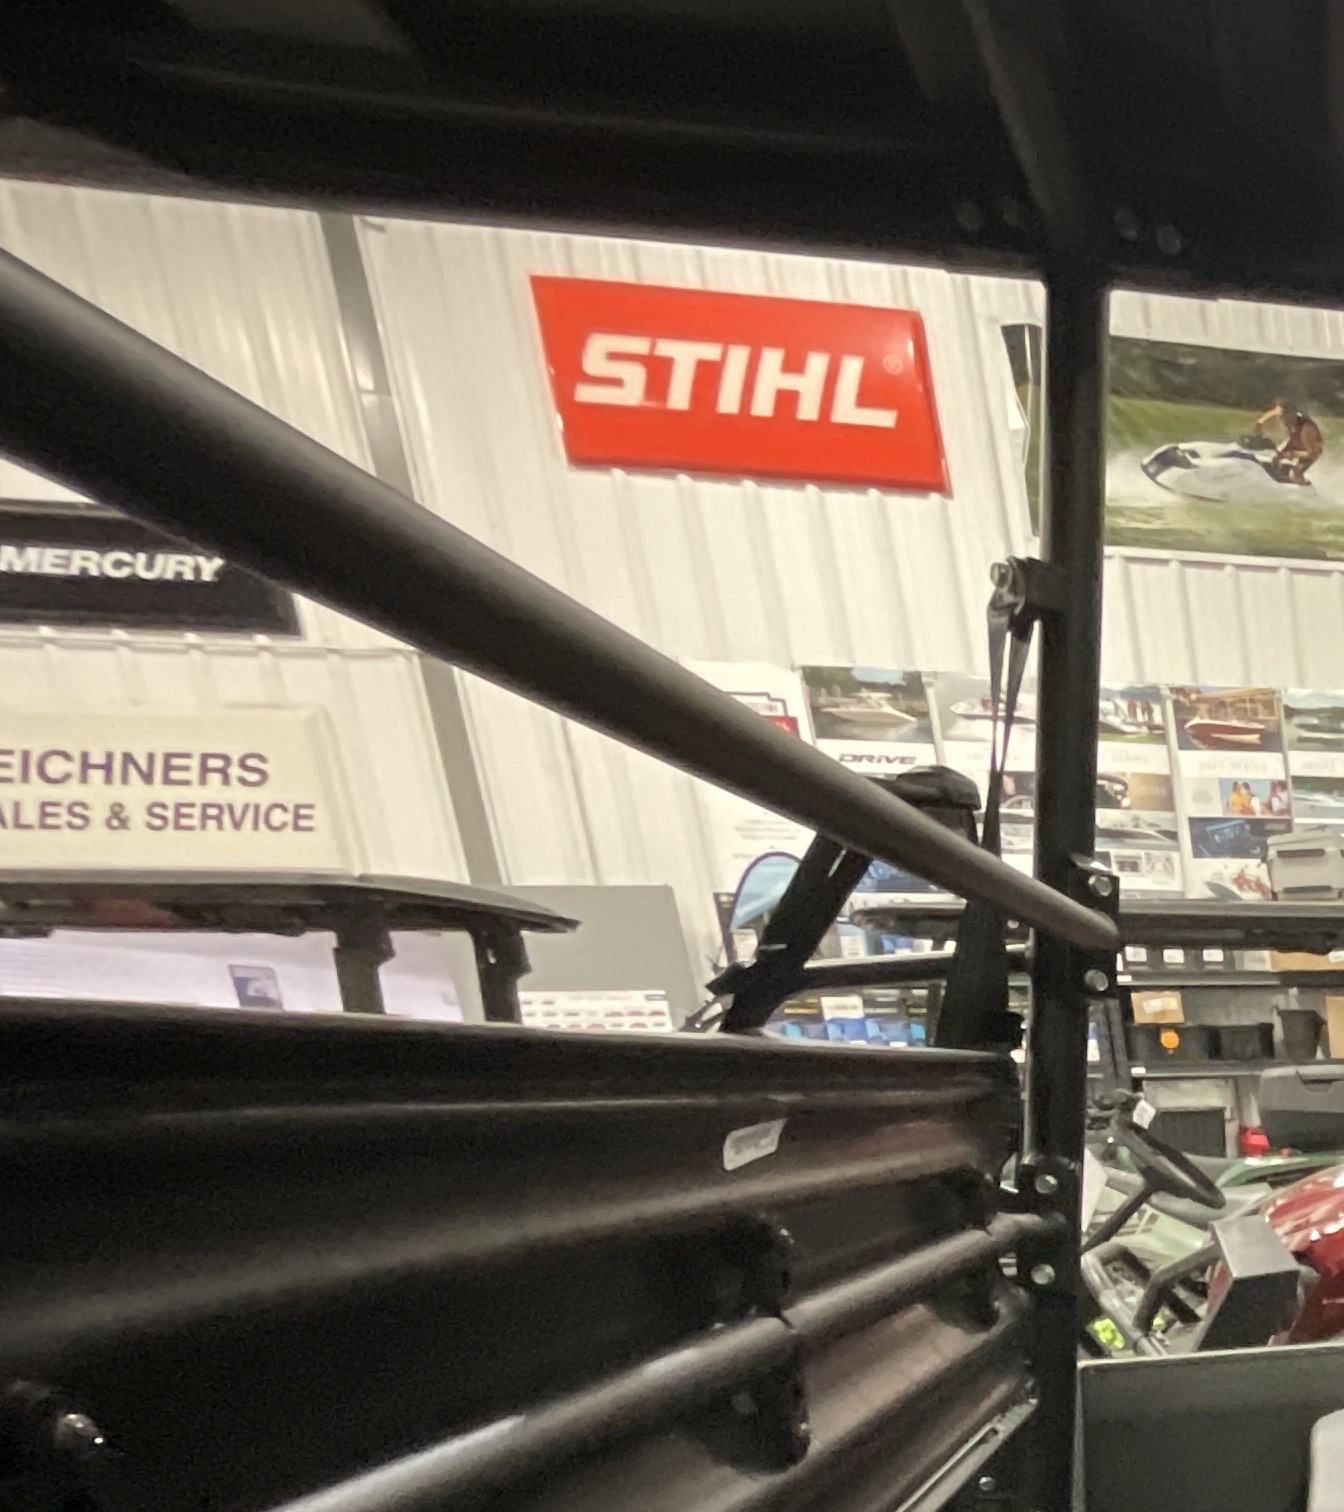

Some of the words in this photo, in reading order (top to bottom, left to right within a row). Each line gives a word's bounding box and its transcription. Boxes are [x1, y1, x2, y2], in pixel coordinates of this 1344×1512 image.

[574, 332, 898, 429] STIHL
[0, 546, 226, 582] MERCURY
[0, 800, 90, 831] LES
[105, 802, 130, 831] &
[145, 802, 316, 833] SERVICE
